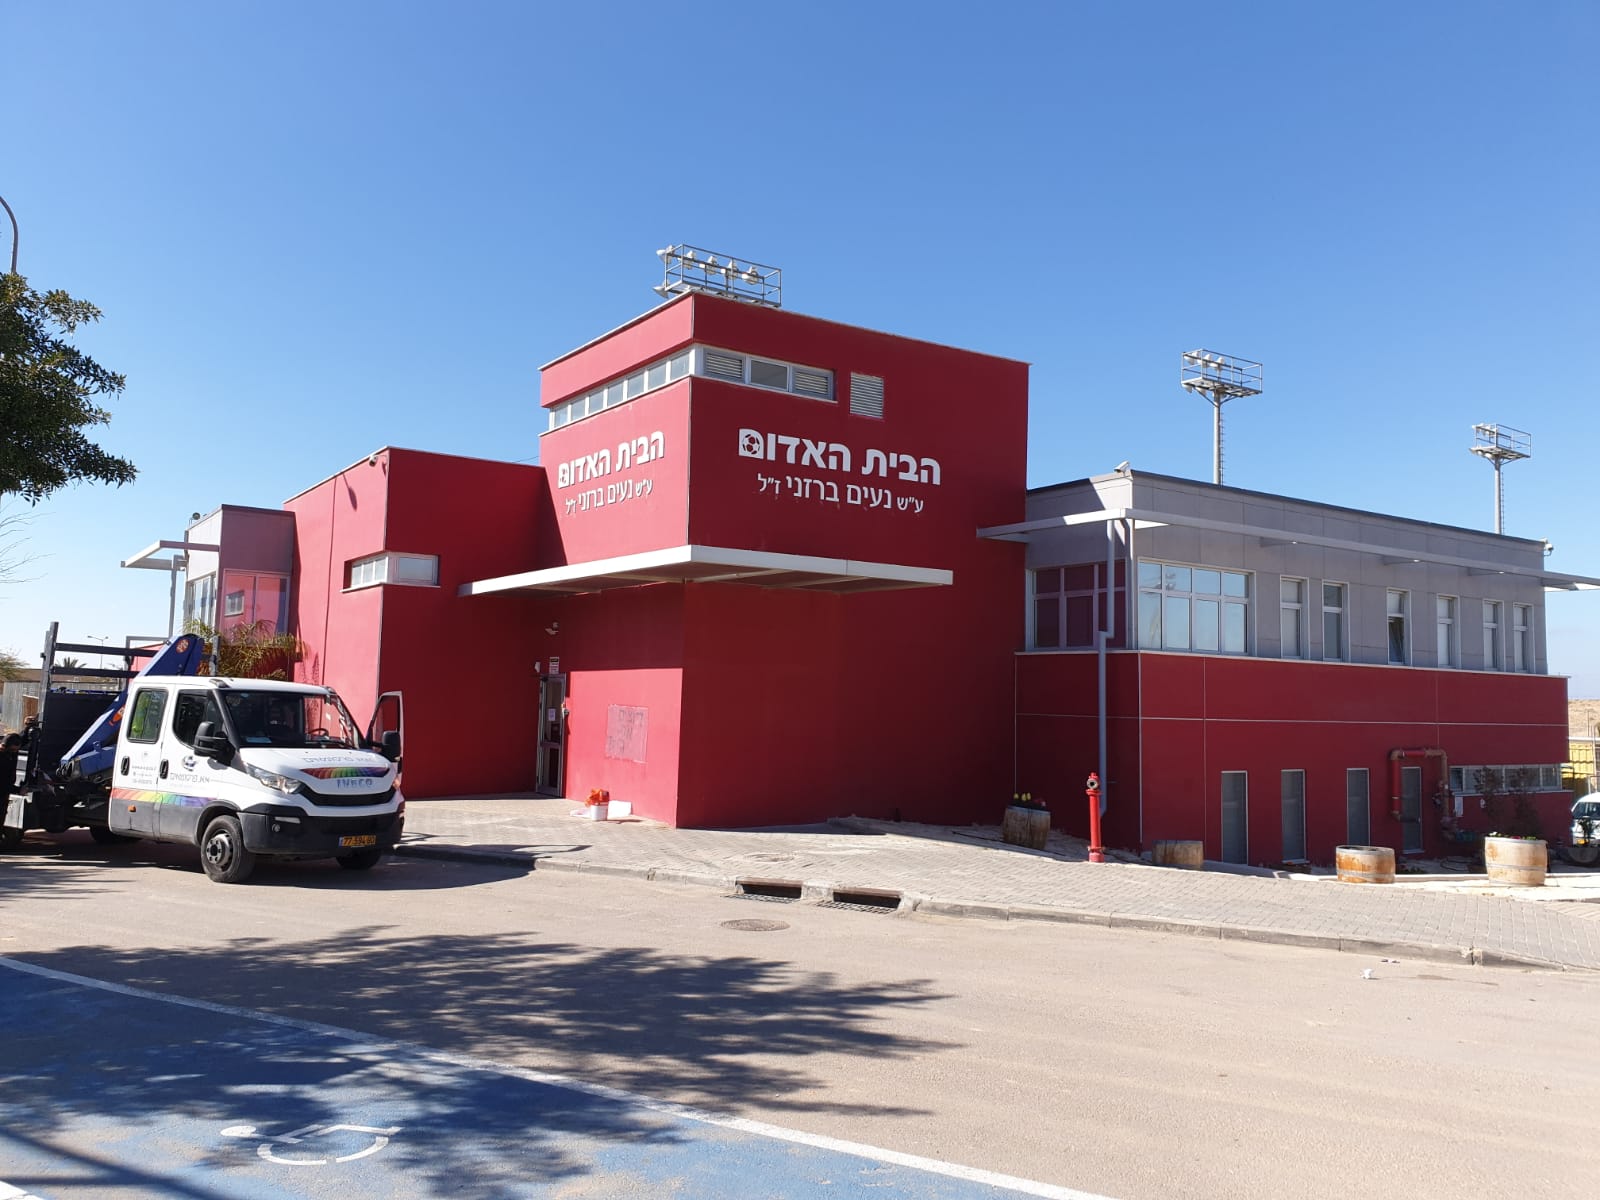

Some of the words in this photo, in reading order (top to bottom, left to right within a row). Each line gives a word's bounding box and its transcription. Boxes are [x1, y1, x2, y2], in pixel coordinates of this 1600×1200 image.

[616, 431, 664, 472] הבית
[738, 428, 851, 472] האדום
[558, 448, 611, 489] האדום
[861, 449, 941, 486] הבית
[578, 487, 605, 511] ברזני
[607, 479, 633, 504] נעים
[785, 475, 840, 502] ברזני
[846, 484, 892, 509] נעים
